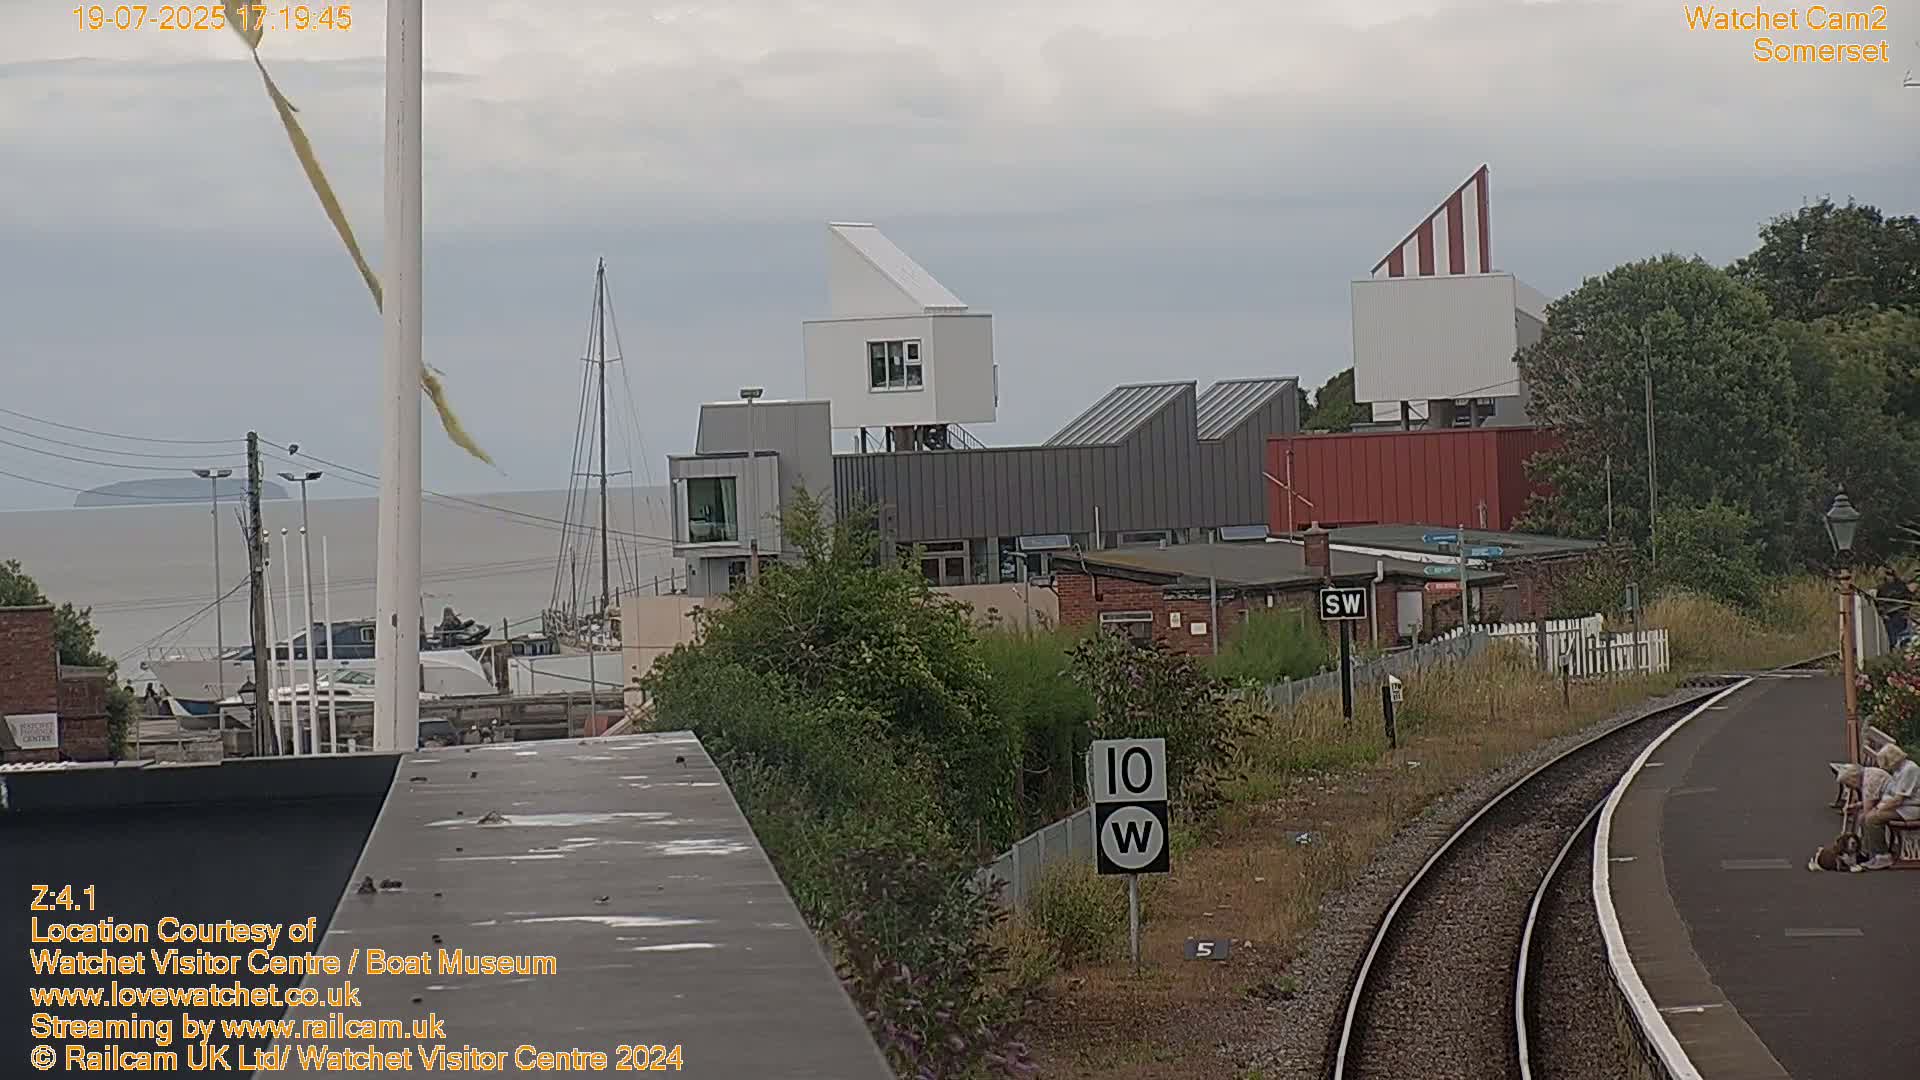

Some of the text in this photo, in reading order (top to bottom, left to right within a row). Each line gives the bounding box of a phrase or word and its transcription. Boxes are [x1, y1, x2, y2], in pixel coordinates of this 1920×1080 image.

[1326, 594, 1360, 614] SW
[1108, 746, 1152, 795] 10
[1111, 820, 1152, 853] W
[1196, 942, 1214, 957] 5
